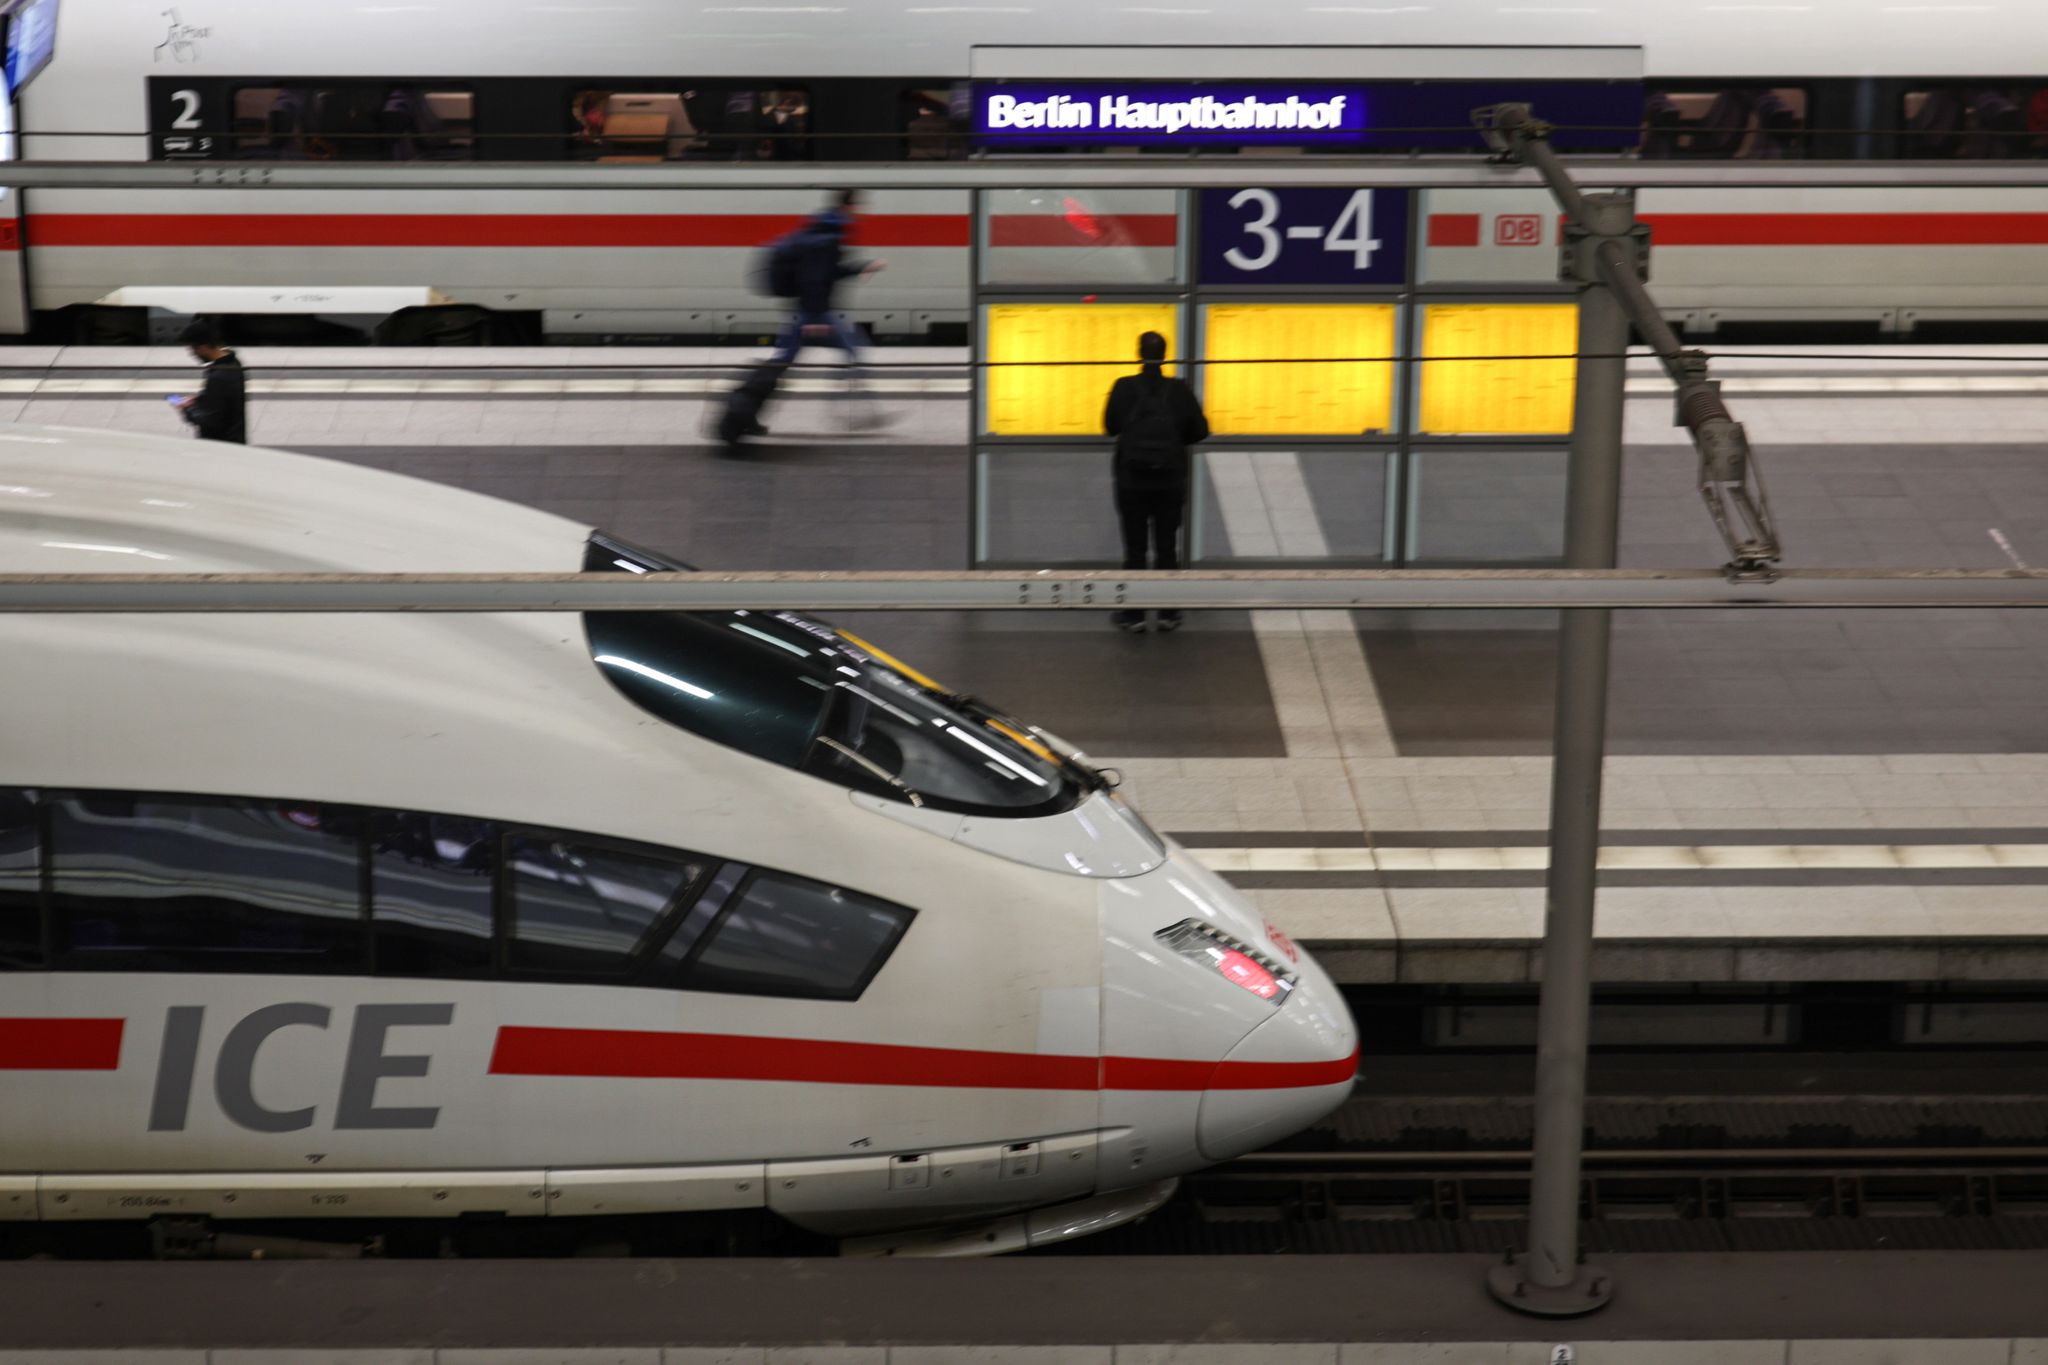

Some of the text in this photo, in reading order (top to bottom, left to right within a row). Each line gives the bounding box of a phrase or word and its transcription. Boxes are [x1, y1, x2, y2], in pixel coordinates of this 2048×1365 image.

[171, 89, 202, 130] 2
[988, 95, 1346, 133] Berlin Hauptbahnhof
[1223, 188, 1383, 270] 3-4
[1500, 219, 1537, 241] DB
[147, 1002, 457, 1133] ICE
